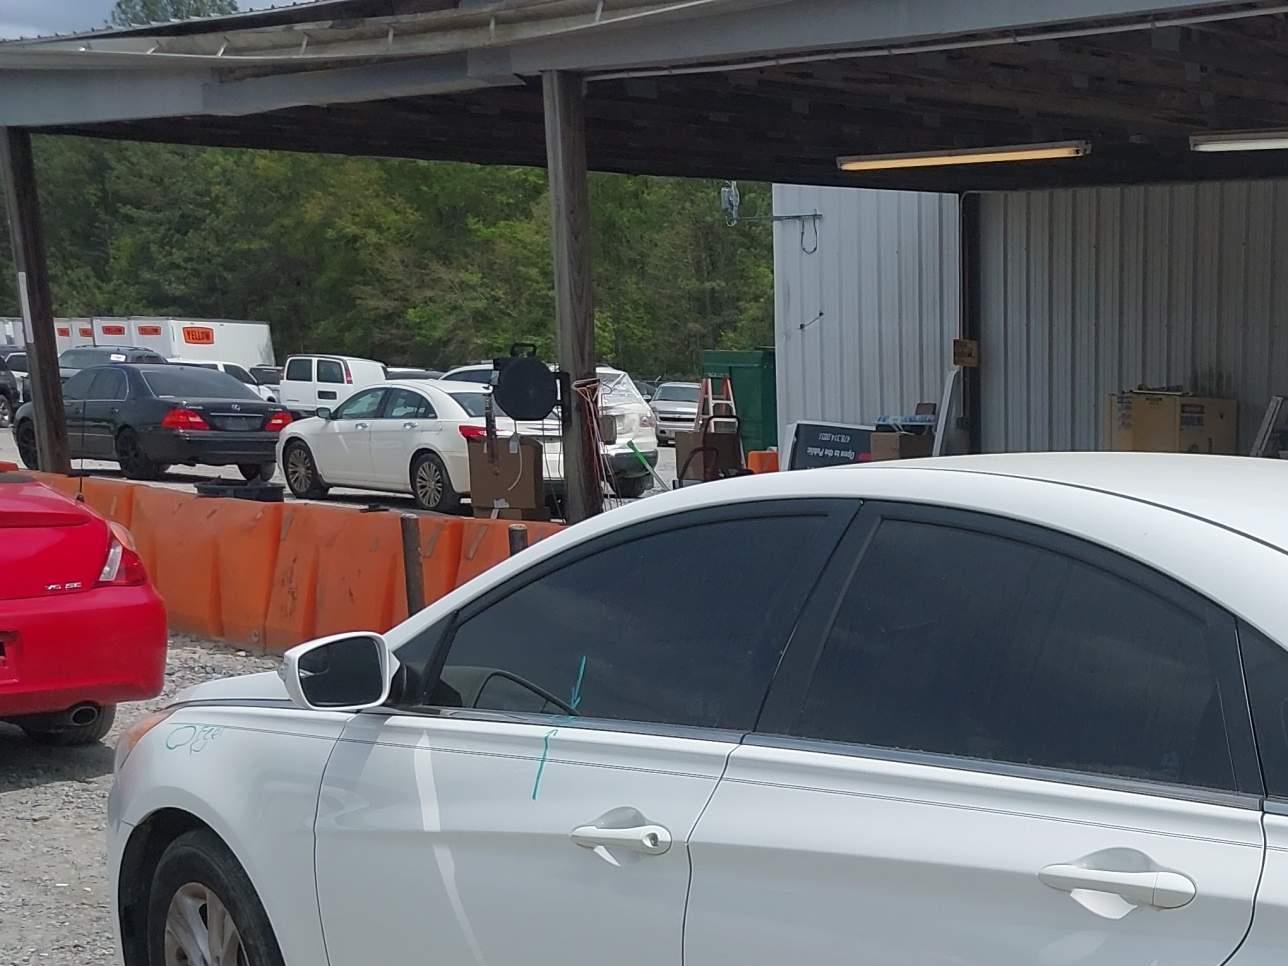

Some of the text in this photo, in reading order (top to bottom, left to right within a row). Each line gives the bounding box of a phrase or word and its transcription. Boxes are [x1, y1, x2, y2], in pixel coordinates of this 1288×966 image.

[187, 330, 211, 340] YELLOW
[807, 447, 824, 457] Public
[840, 450, 855, 460] Open
